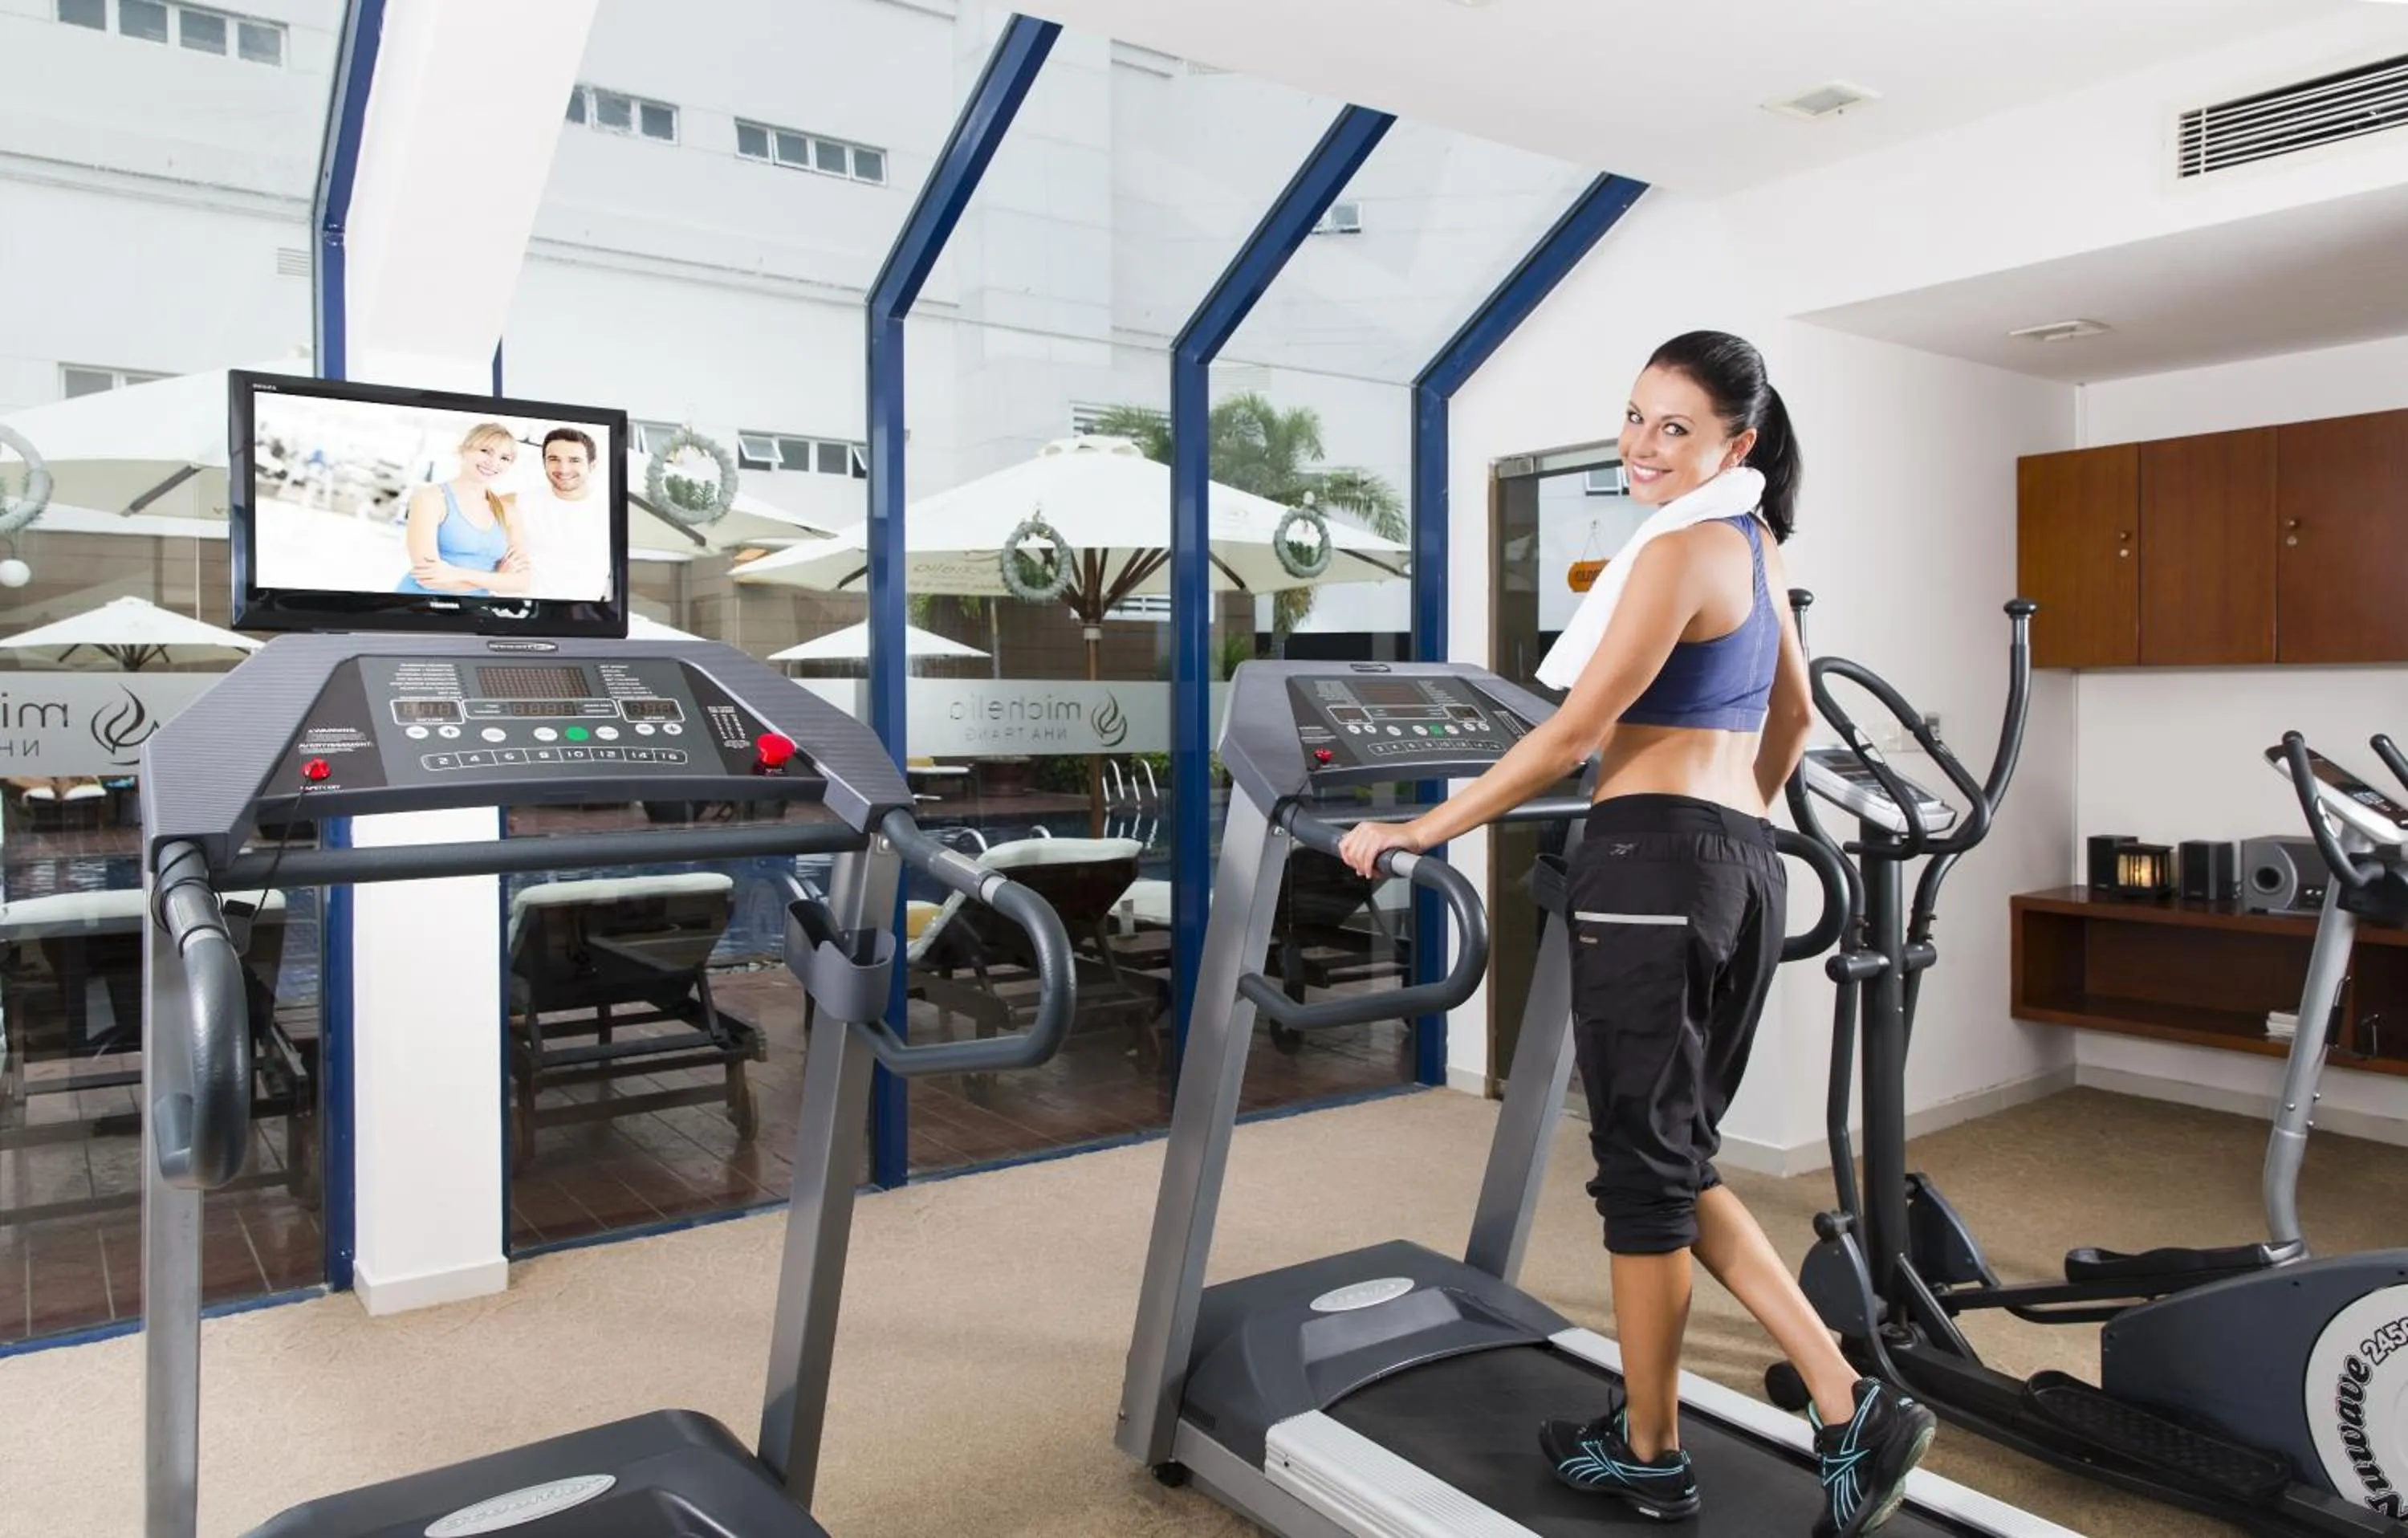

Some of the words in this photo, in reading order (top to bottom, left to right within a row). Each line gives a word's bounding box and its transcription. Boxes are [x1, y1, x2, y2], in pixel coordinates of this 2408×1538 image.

[437, 757, 449, 765] 2
[504, 752, 515, 760] 6
[567, 750, 584, 758] 10
[600, 750, 616, 758] 12
[632, 751, 648, 759] 14
